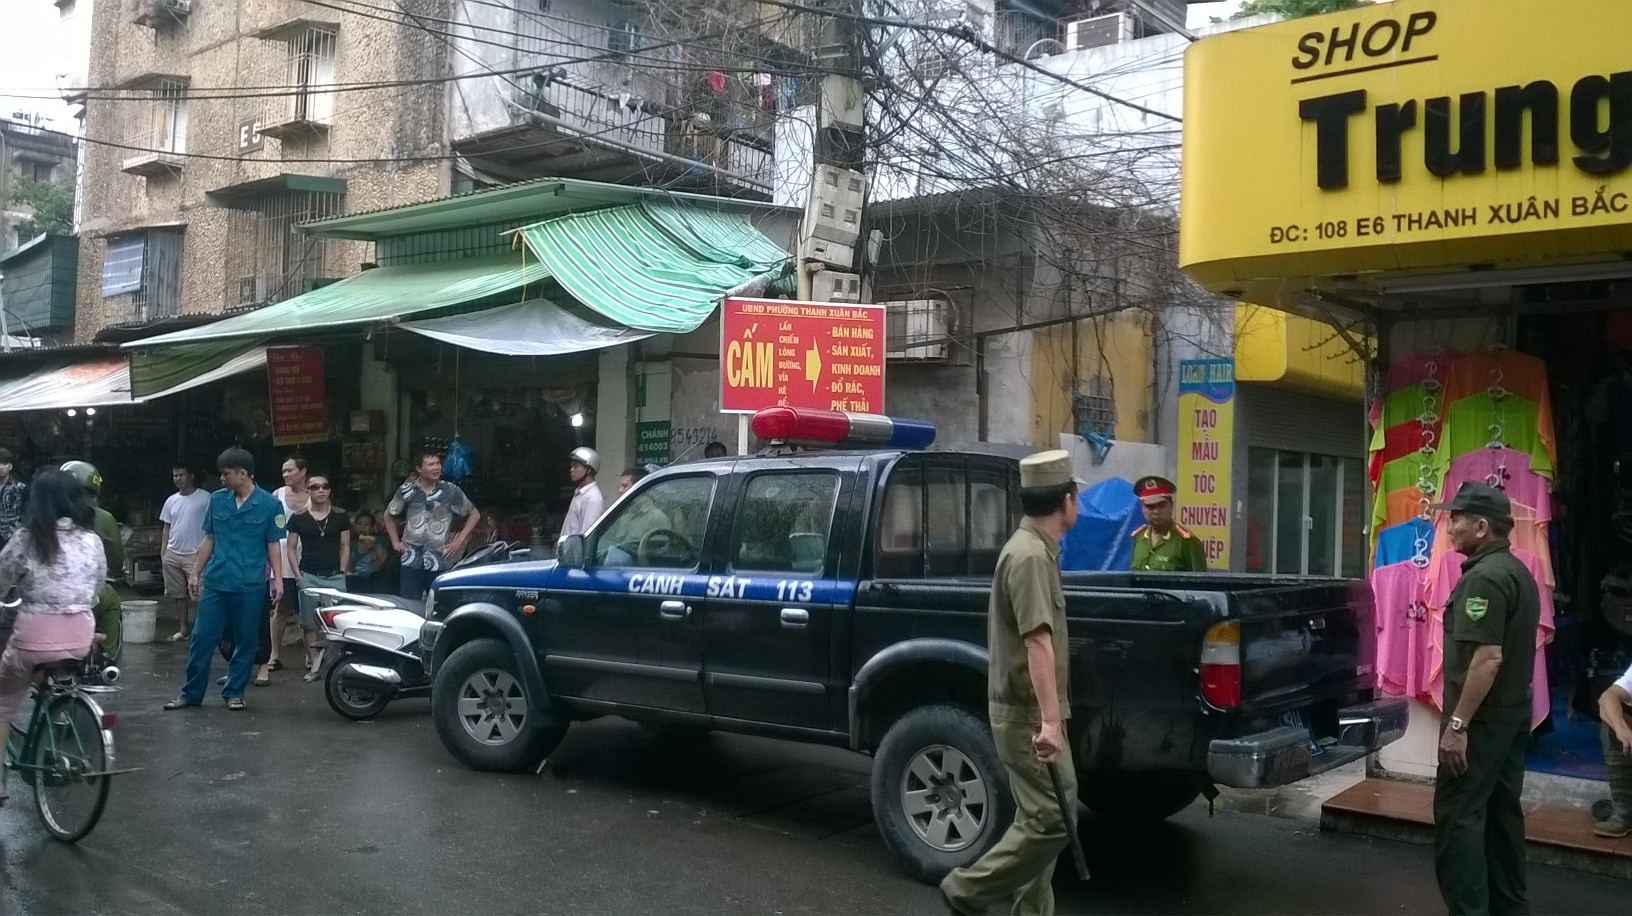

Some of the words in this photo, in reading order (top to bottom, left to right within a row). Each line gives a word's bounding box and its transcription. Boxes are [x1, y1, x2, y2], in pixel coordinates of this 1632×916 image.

[1291, 11, 1437, 70] SHOP
[1299, 71, 1632, 190] Trung
[1270, 226, 1308, 243] ĐC:
[1314, 221, 1348, 240] 108
[1357, 217, 1384, 236] E6
[1392, 207, 1477, 233] THANH
[1488, 196, 1560, 224] XUÂN
[1571, 185, 1630, 217] BẮC
[742, 304, 764, 313] UBND
[767, 305, 799, 315] PHƯỜNG
[801, 307, 827, 316] THANH
[829, 308, 850, 318] XUÂN
[852, 309, 868, 319] BẮC
[779, 320, 792, 331] LẤN
[851, 327, 874, 339] HÀNG
[727, 323, 774, 388] CẤM
[850, 343, 874, 359] XUẤT,
[832, 363, 851, 374] KINH
[853, 364, 881, 376] DOANH
[846, 381, 865, 395] RÁC,
[831, 397, 848, 411] PHẾ
[850, 398, 870, 412] THẢI
[1194, 409, 1217, 432] TẠO
[1193, 470, 1215, 493] TÓC
[1180, 503, 1227, 526] CHUYÊN
[707, 575, 751, 598] SÁT
[777, 580, 814, 601] 113
